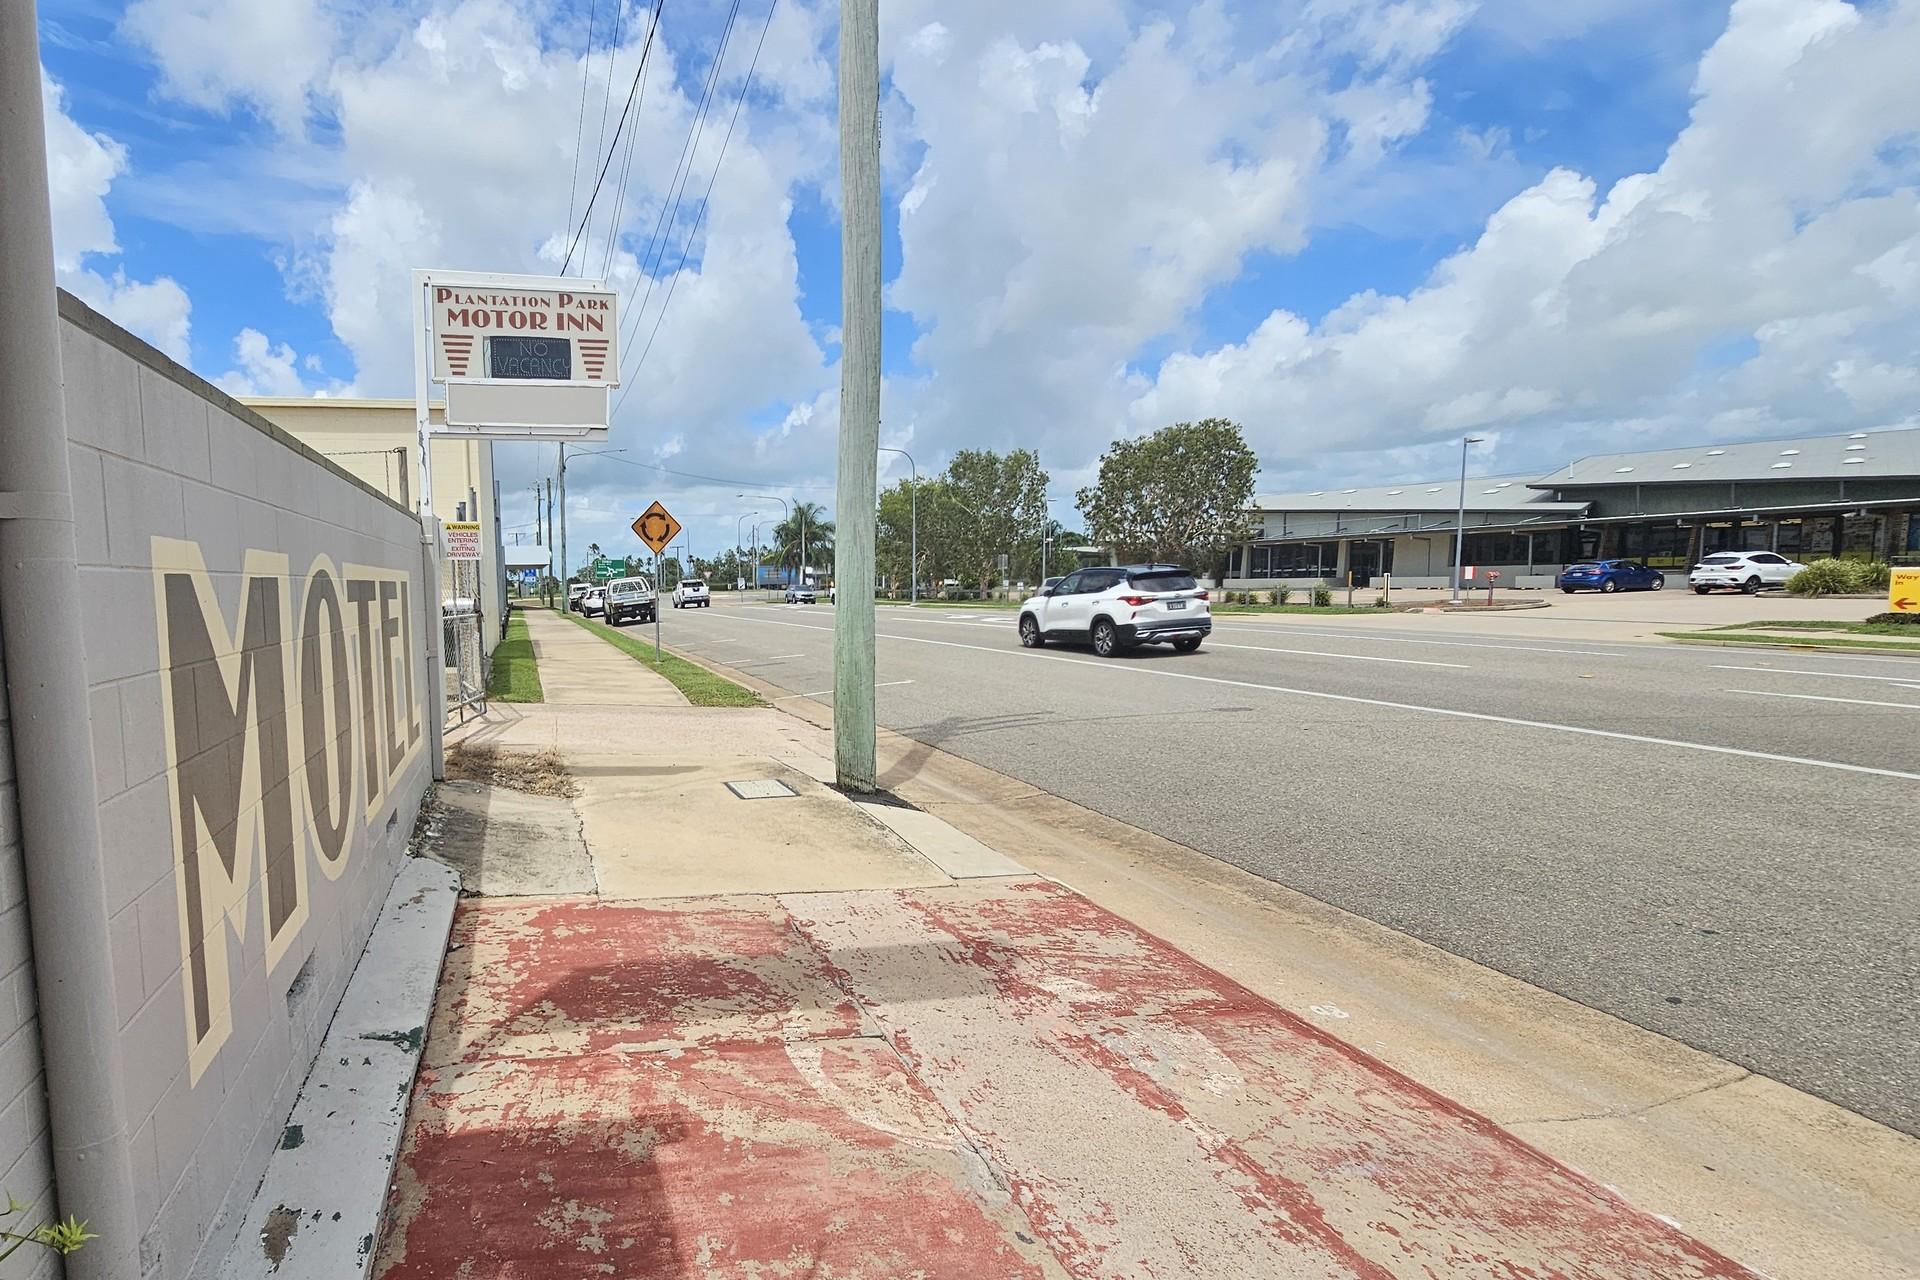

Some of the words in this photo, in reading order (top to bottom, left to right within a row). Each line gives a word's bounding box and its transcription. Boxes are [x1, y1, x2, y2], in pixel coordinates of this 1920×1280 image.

[436, 287, 551, 308] PLANTATION
[558, 293, 609, 310] PARK
[447, 308, 548, 330] MOTOR
[556, 312, 604, 332] INN
[519, 341, 548, 357] NO
[497, 356, 570, 378] VACANCY
[150, 535, 424, 1089] MOTEL
